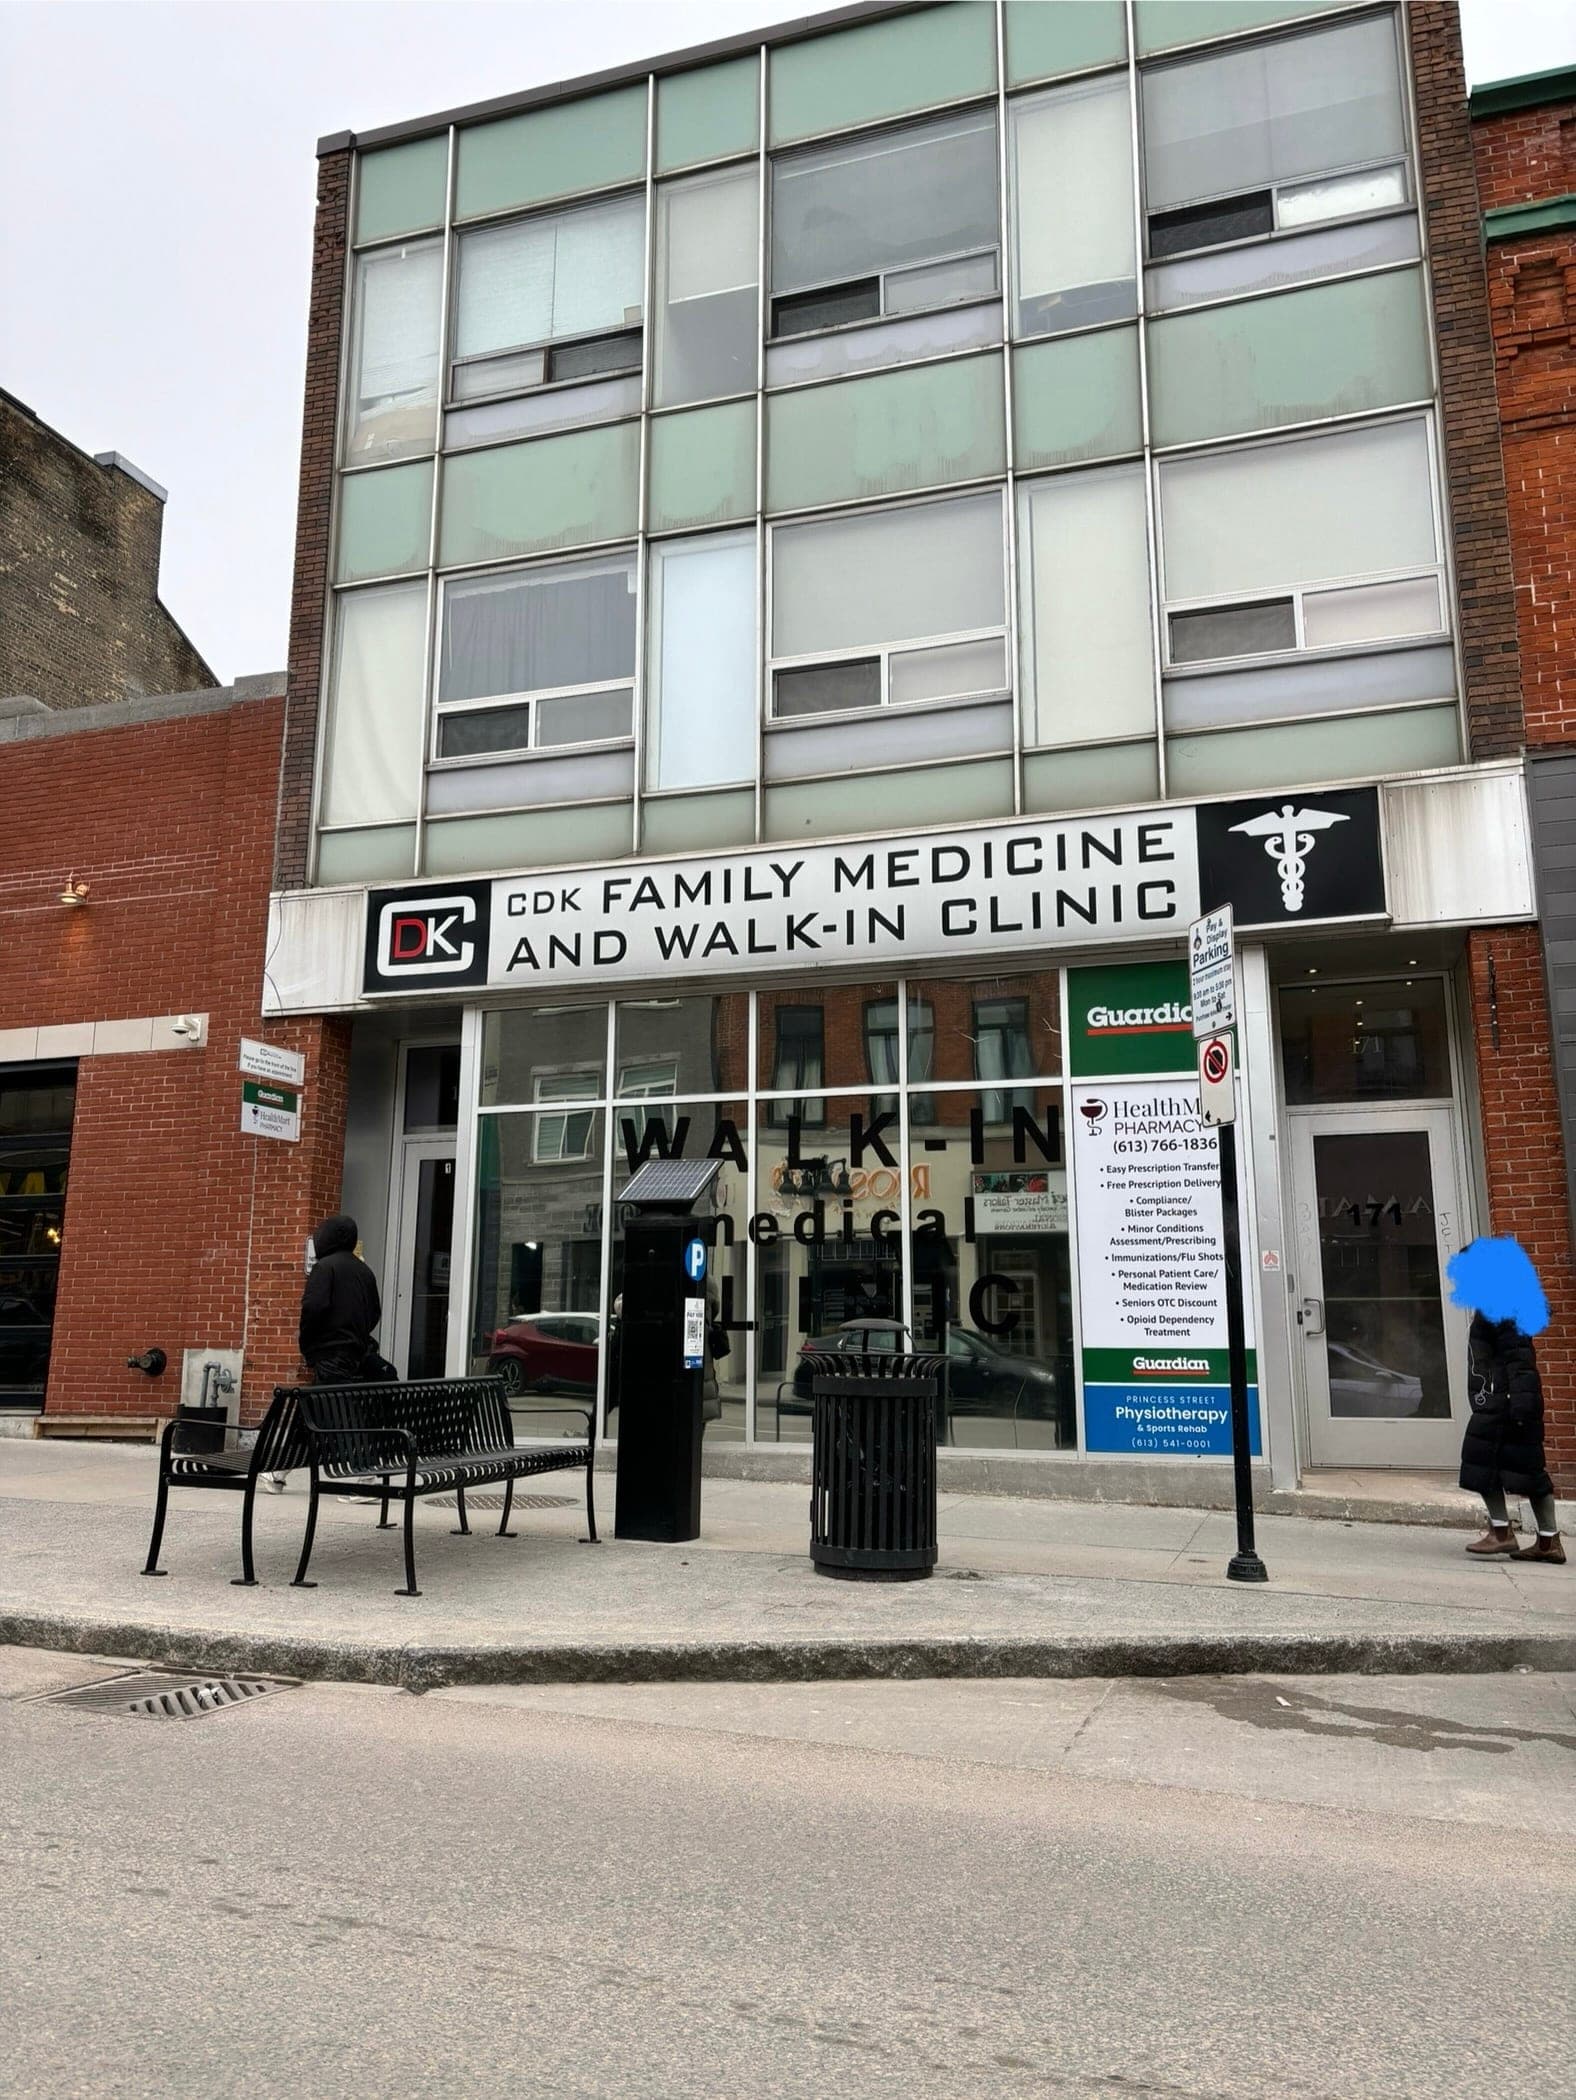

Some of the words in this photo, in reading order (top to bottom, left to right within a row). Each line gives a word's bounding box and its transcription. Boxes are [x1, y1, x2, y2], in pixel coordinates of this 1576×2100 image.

[506, 887, 583, 917] CDK
[602, 860, 806, 914] FAMILY
[834, 822, 1175, 893] MEDICINE
[506, 930, 627, 972] AND
[654, 904, 905, 960] WALK-IN
[941, 880, 1177, 937] CLINIC
[1206, 922, 1218, 934] Pay
[1206, 928, 1229, 944] Display
[1193, 941, 1229, 968] Parking
[1114, 1119, 1204, 1135] PHARMACY
[1113, 1140, 1147, 1154] (613)
[1151, 1138, 1217, 1152] 766-1836
[1106, 1165, 1126, 1175] Easy
[1128, 1164, 1181, 1176] Prescription
[1106, 1181, 1126, 1190] Free
[1128, 1180, 1181, 1192] Prescription
[1184, 1179, 1221, 1190] Delivery
[1136, 1195, 1192, 1206] Compliance/
[1125, 1208, 1154, 1217] Blister
[1156, 1208, 1197, 1219] Packages
[1347, 1202, 1401, 1225] 171
[1127, 1225, 1154, 1233] Minor
[1156, 1224, 1204, 1232] Conditions
[1110, 1236, 1216, 1247] Assessment/Prescribing
[1111, 1253, 1196, 1262] Immunizations/Flu
[1198, 1253, 1224, 1261] Shots
[1118, 1269, 1157, 1278] Personal
[1159, 1269, 1191, 1278] Patient
[1193, 1269, 1219, 1279] Care/
[1123, 1282, 1173, 1291] Medication
[1175, 1282, 1207, 1290] Review
[1122, 1298, 1155, 1307] Seniors
[1157, 1299, 1176, 1307] OTC
[1178, 1298, 1217, 1307] Discount
[1127, 1315, 1156, 1326] Opioid
[1159, 1315, 1215, 1326] Dependency
[1144, 1328, 1191, 1336] Treatment
[1132, 1357, 1210, 1370] Guardian
[1126, 1395, 1175, 1404] PRINCESS
[1179, 1396, 1215, 1404] STREET
[1116, 1406, 1228, 1424] Physiotherapy
[1146, 1425, 1176, 1434] Sports
[1178, 1425, 1207, 1433] Rehab
[1131, 1438, 1158, 1448] (613)
[1163, 1439, 1211, 1448] 541-0001
